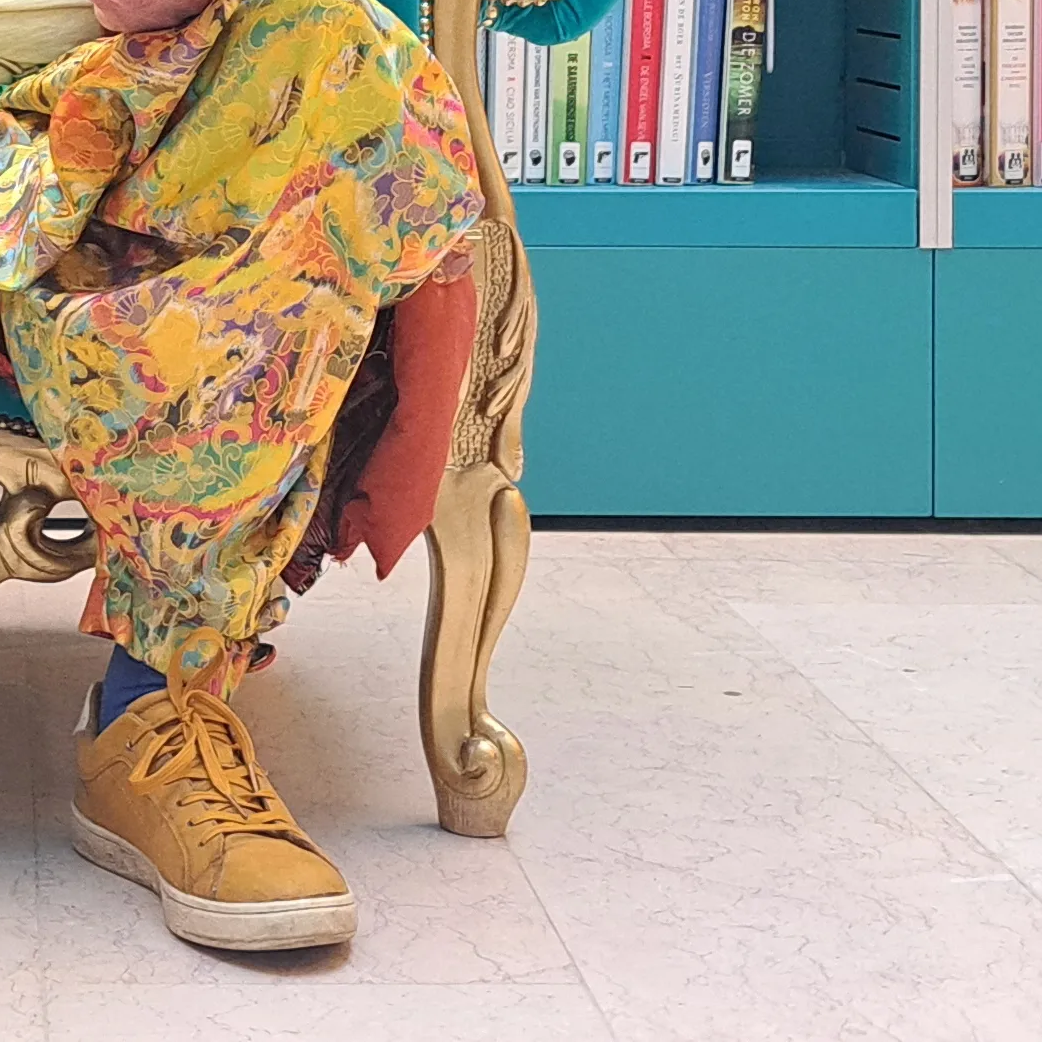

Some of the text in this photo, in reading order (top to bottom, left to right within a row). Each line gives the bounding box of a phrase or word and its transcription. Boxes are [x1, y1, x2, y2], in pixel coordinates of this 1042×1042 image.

[677, 8, 686, 20] DE
[567, 52, 579, 64] DE
[737, 32, 756, 116] DIE ZOMER
